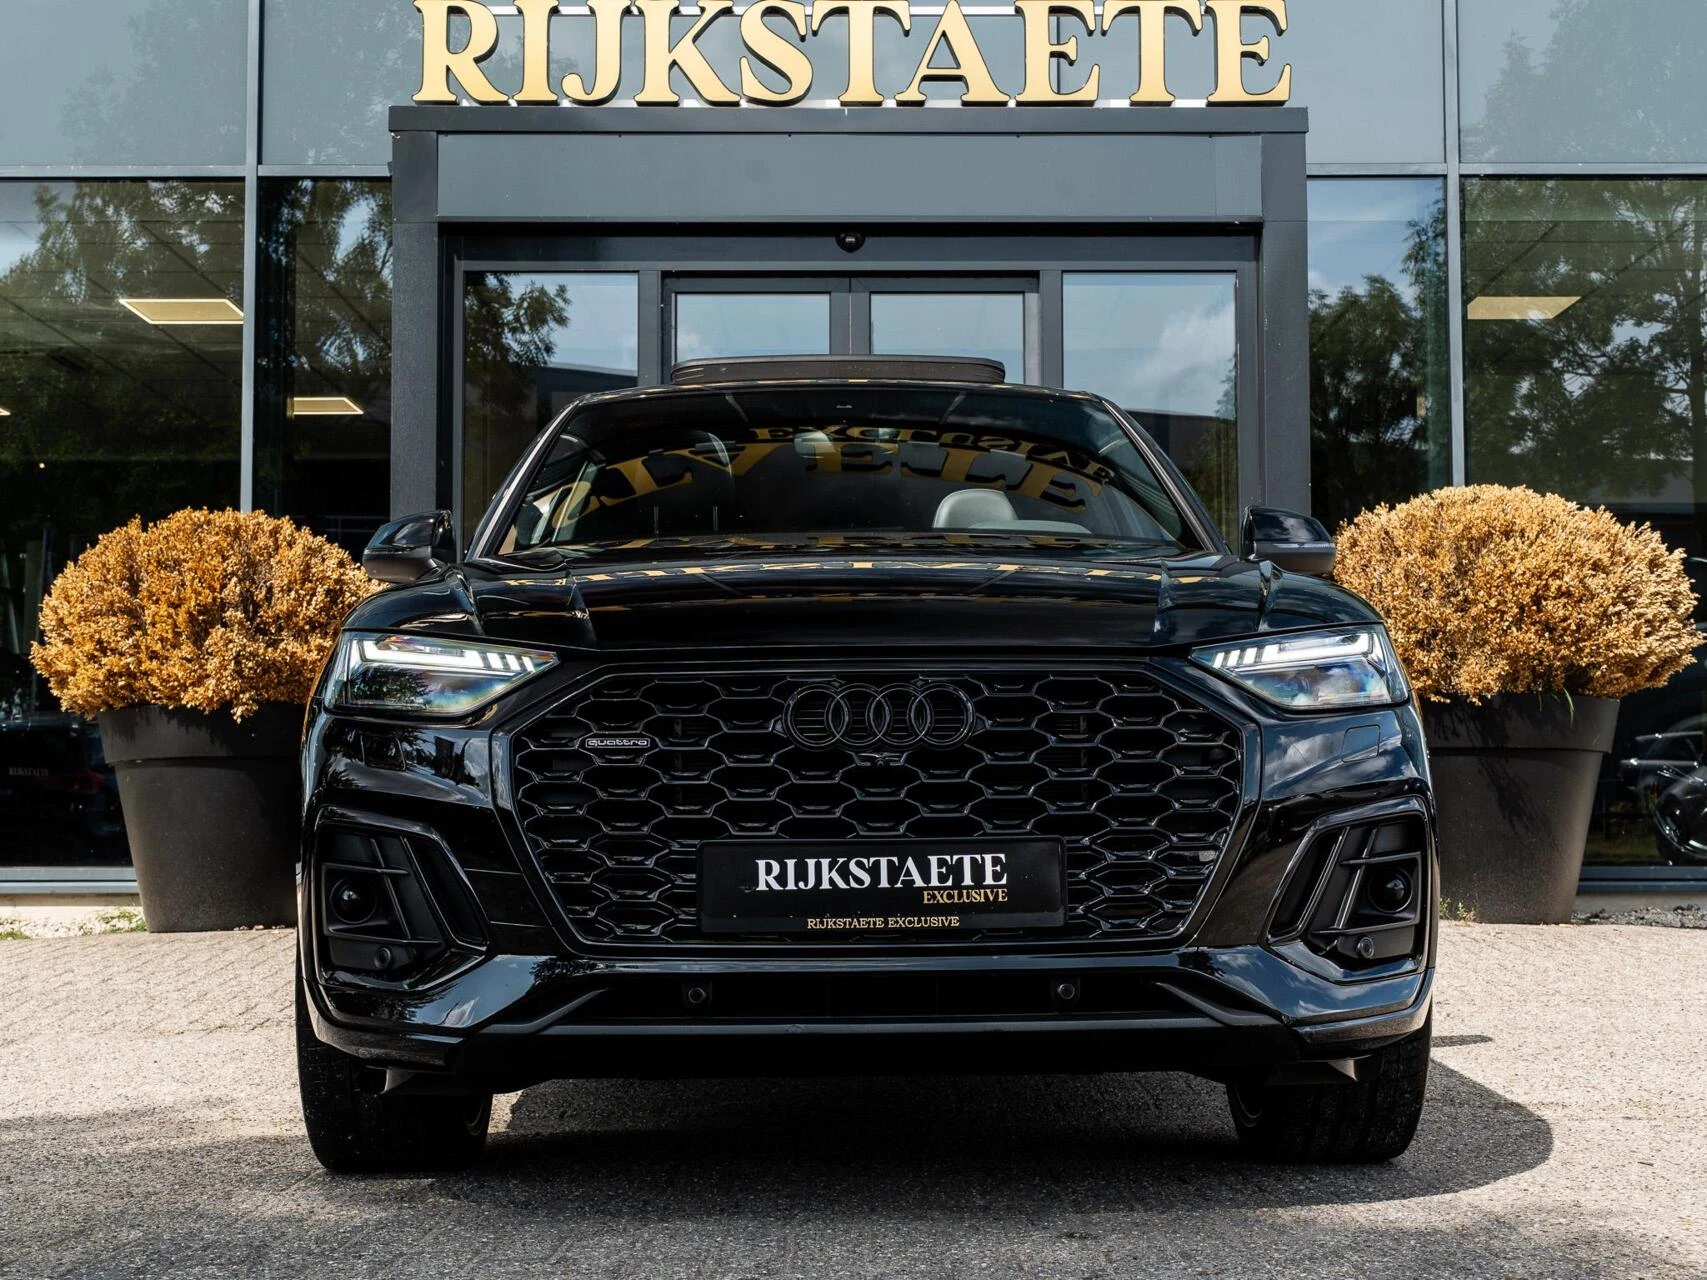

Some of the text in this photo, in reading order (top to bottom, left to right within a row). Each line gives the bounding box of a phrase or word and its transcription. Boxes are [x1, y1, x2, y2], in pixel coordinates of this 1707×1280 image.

[412, 0, 1292, 105] RIJKSTAETE
[588, 739, 647, 747] quattro
[755, 853, 1008, 891] RIJKSTAETE
[923, 889, 1008, 904] EXCLUSIVE
[807, 915, 960, 929] RIJKSTAETE EXCLUSIVE
